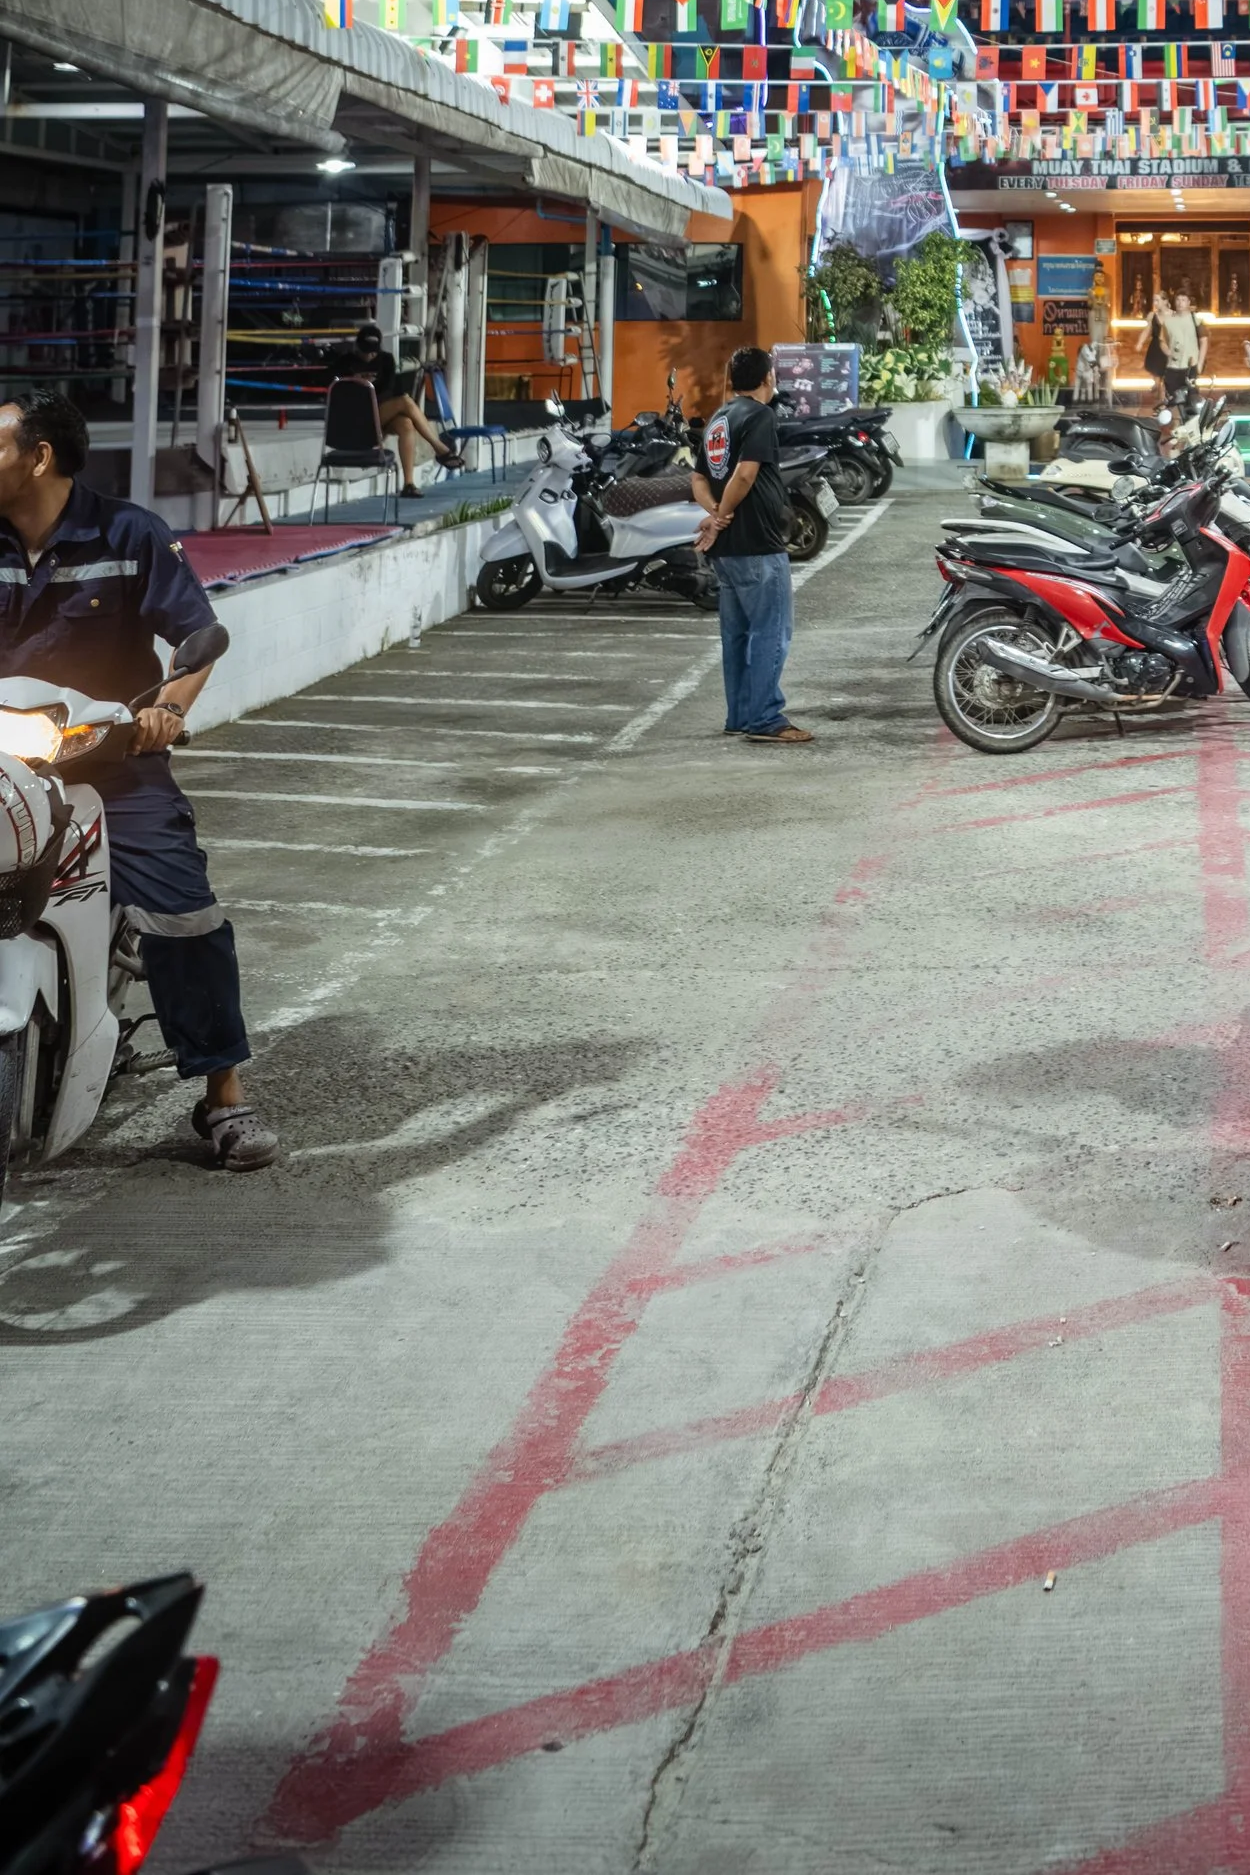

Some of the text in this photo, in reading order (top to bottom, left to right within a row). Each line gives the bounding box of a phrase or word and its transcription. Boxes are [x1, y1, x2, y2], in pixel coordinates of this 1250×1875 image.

[1032, 159, 1086, 175] MUAY
[1090, 159, 1131, 175] THAI
[1137, 158, 1220, 174] STADIUM
[1227, 159, 1242, 173] &
[999, 176, 1045, 190] EVERY
[1046, 176, 1109, 190] TUESDAY
[1117, 175, 1169, 189] FRIDAY
[1170, 175, 1229, 189] SUNDAY
